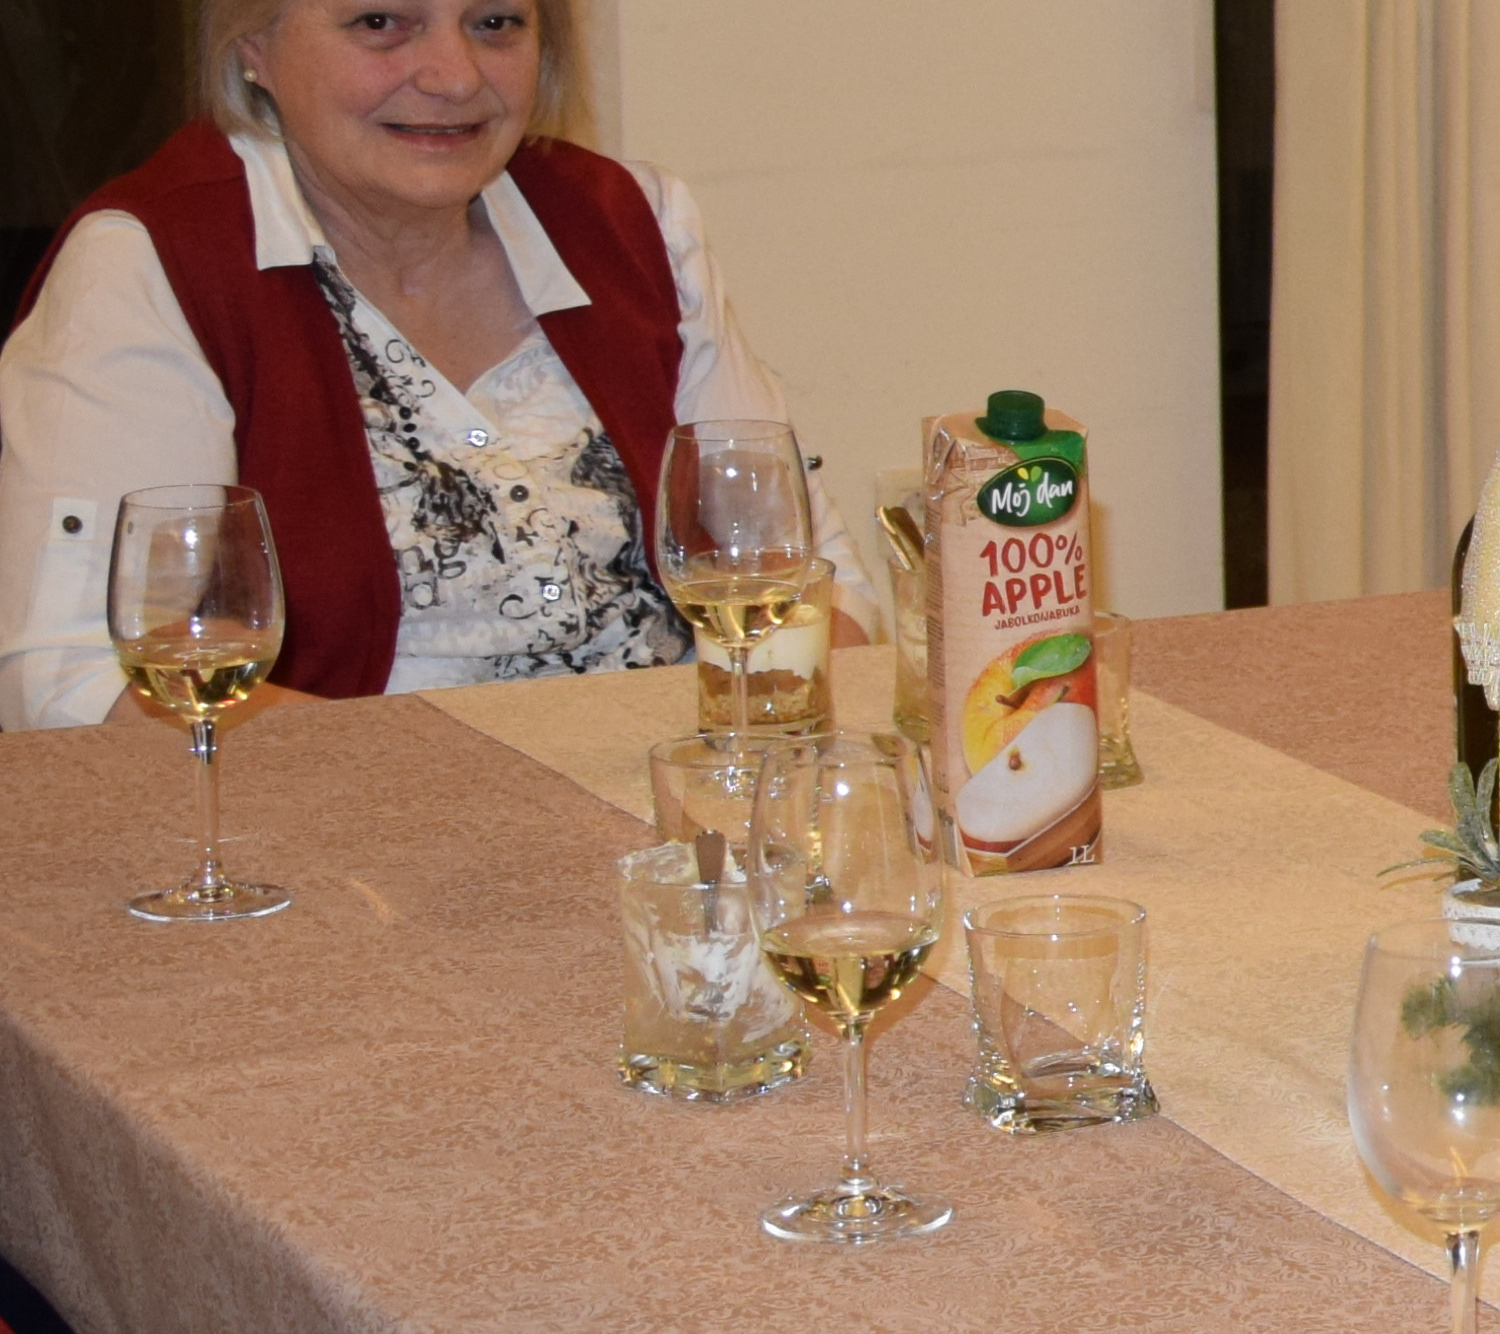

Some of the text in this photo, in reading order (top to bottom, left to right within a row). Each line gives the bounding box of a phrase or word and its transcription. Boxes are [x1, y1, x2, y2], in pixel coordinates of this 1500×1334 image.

[992, 471, 1073, 517] Moj dan
[979, 531, 1083, 577] 100%
[982, 563, 1087, 617] APPLE
